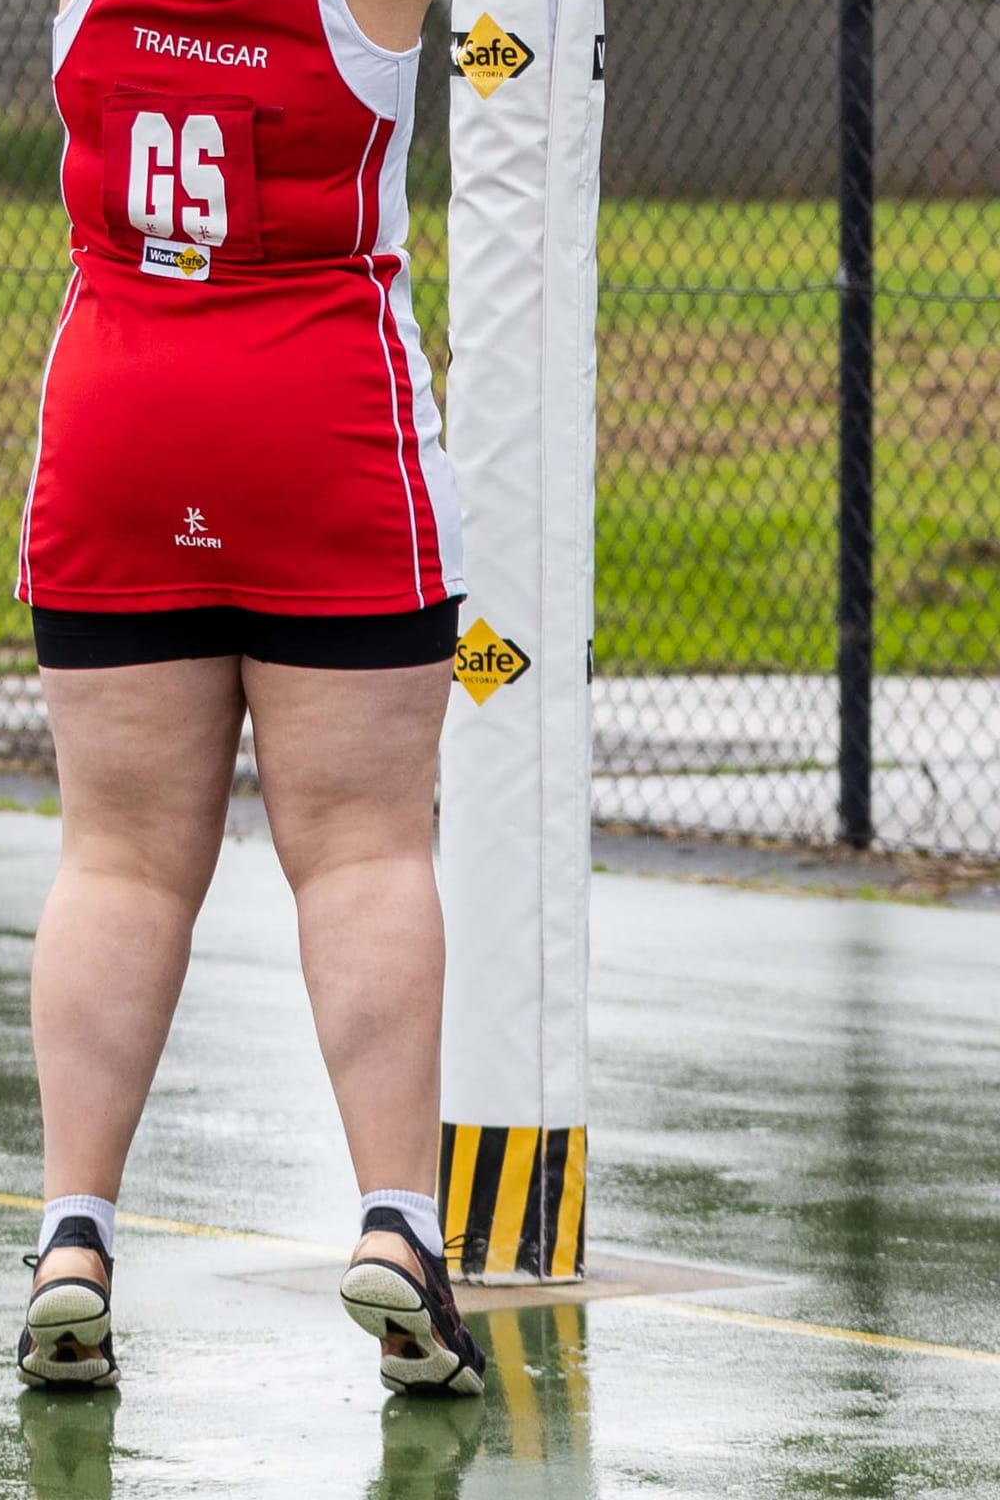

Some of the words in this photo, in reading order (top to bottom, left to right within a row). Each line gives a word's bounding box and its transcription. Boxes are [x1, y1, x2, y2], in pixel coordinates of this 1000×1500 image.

[133, 26, 269, 69] TRAFALGAR
[127, 111, 229, 248] GS
[174, 534, 222, 549] KUKRI
